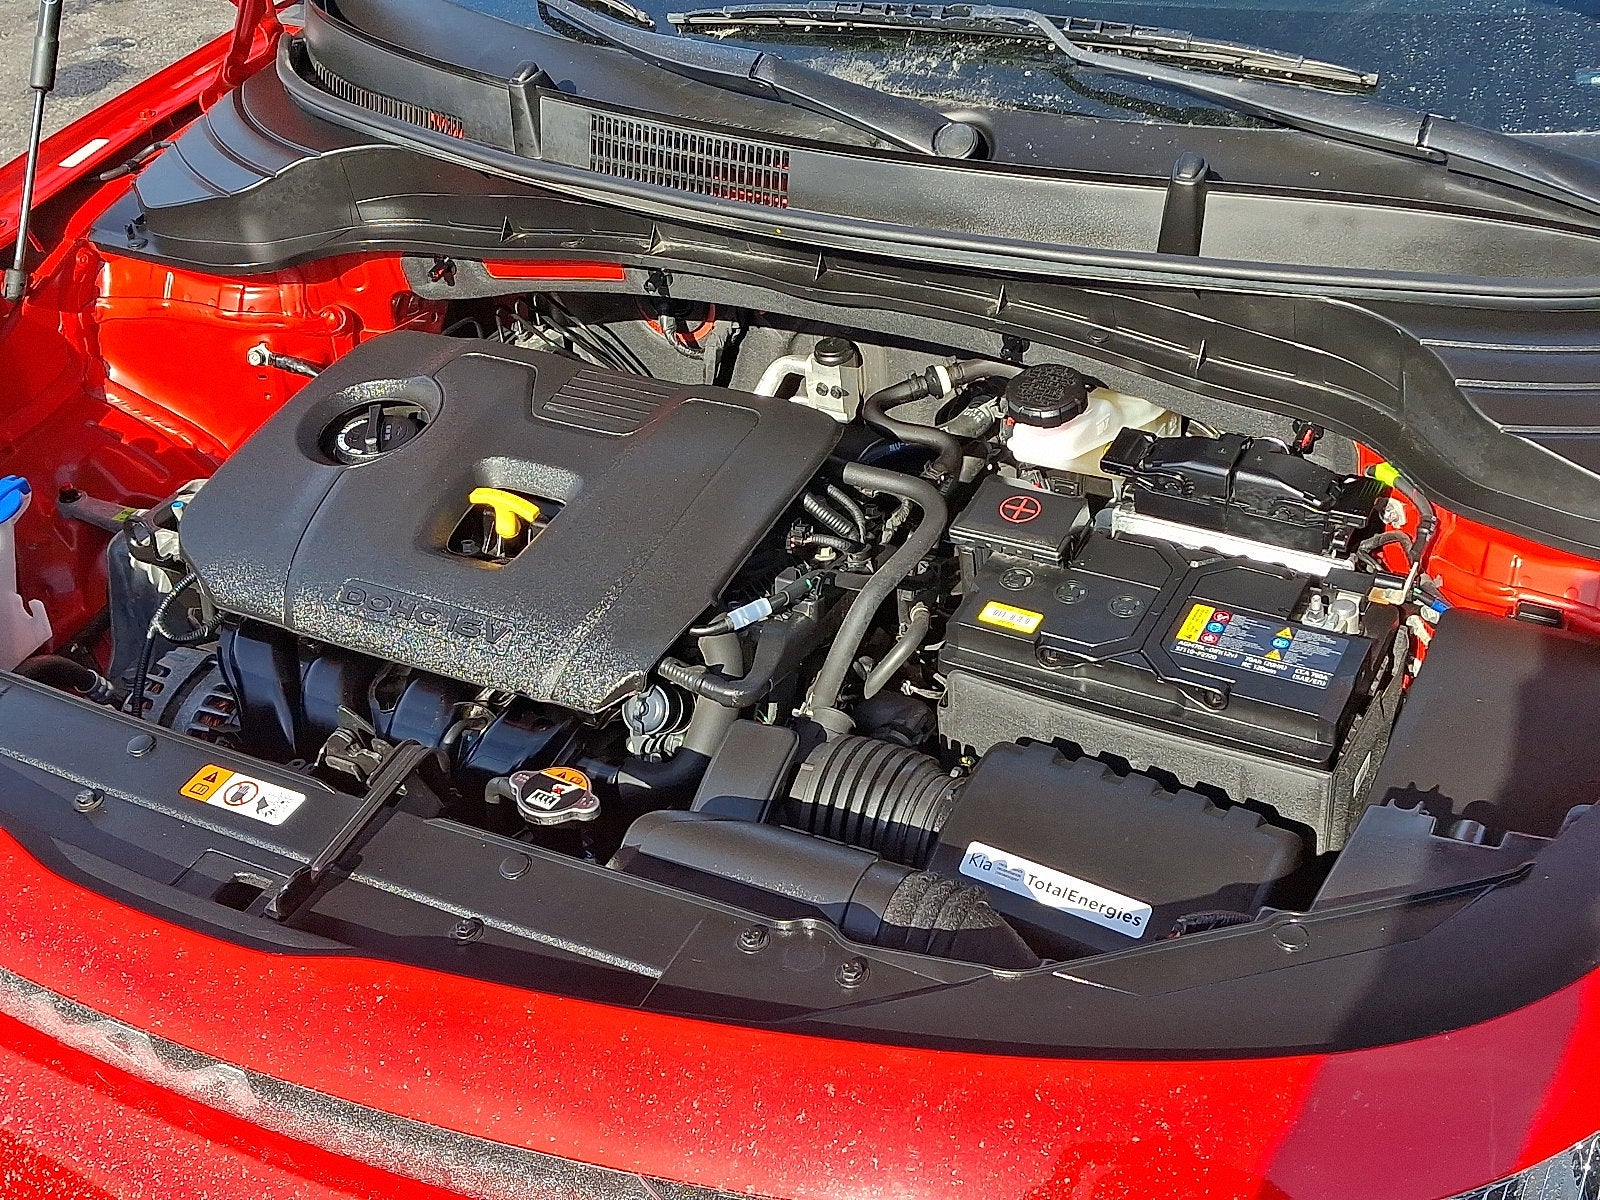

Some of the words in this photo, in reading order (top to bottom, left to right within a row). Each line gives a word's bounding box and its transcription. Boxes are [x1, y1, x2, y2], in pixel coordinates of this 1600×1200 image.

[339, 586, 442, 627] DOHC
[968, 852, 993, 872] Kia
[1028, 873, 1142, 926] TotalEnergies
